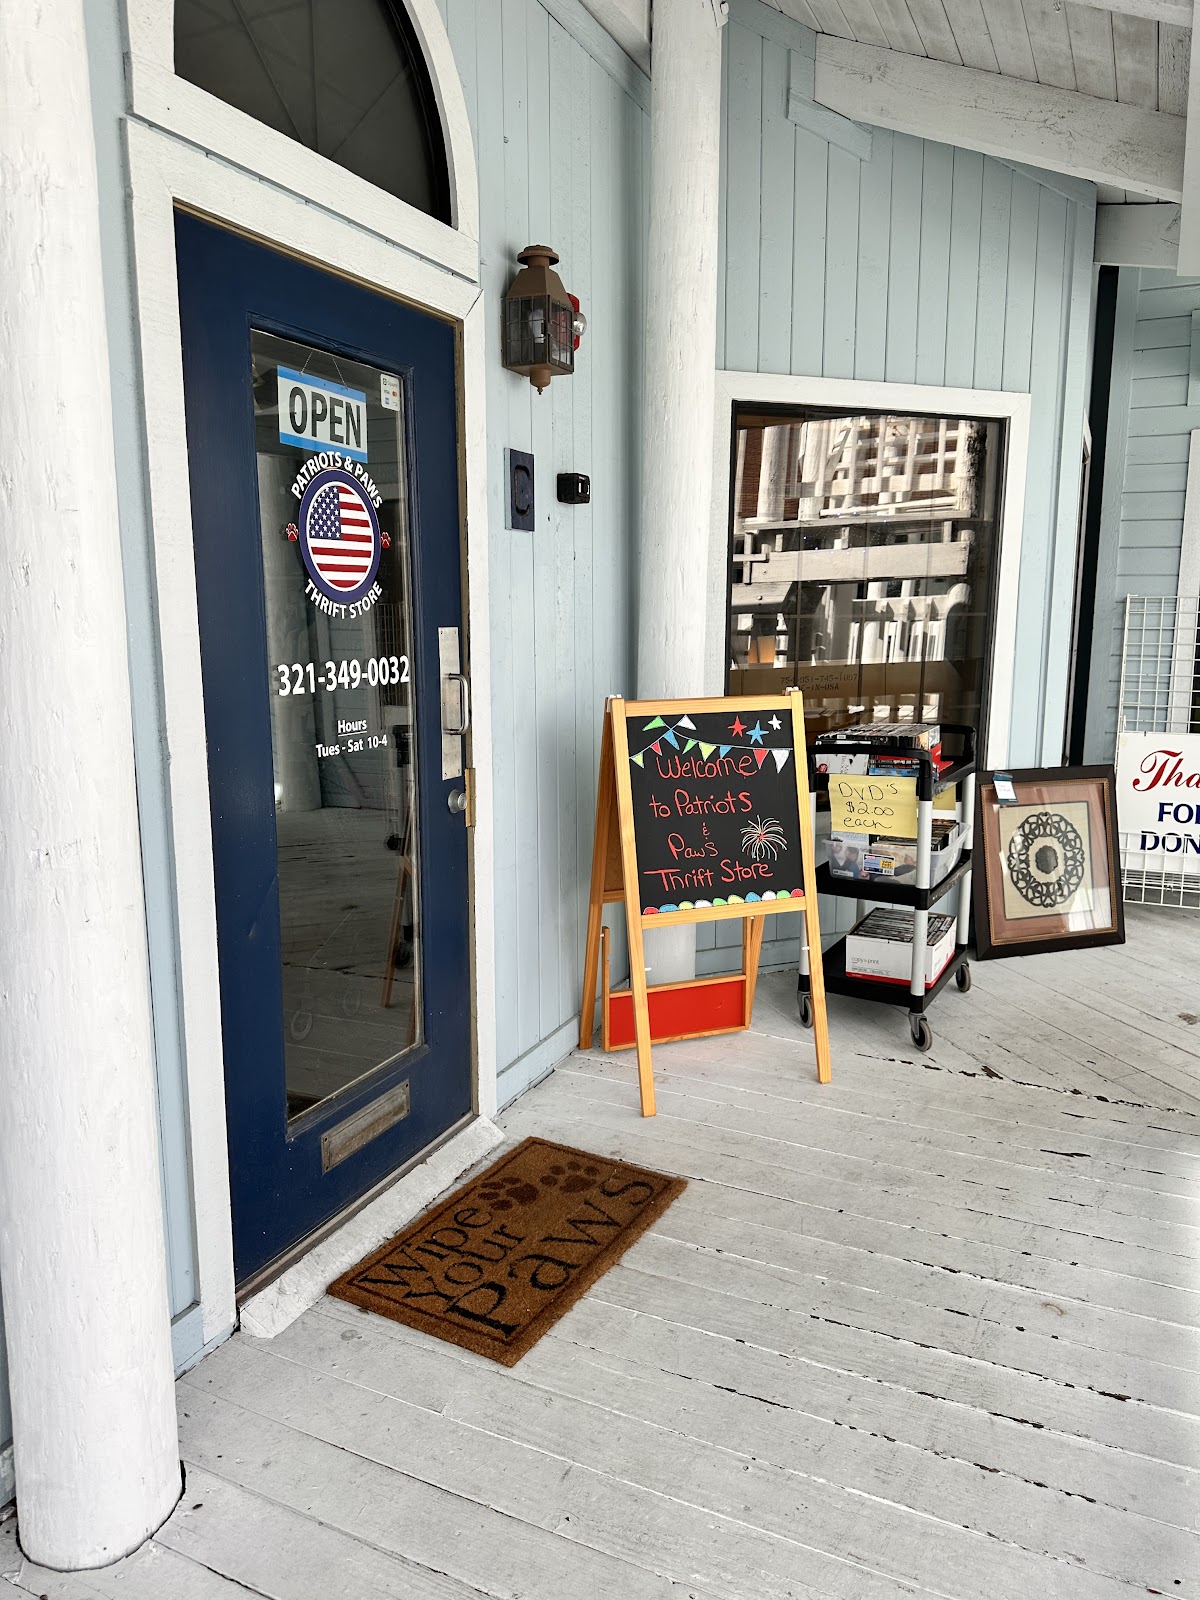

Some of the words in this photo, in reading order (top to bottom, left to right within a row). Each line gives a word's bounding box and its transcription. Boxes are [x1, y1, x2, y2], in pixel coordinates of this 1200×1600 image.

[288, 386, 362, 448] OPEN
[291, 451, 341, 499] PATRIOTS
[343, 455, 354, 472] &
[354, 466, 383, 508] PAWS
[304, 578, 347, 619] THRIFT
[350, 580, 383, 619] STORE
[277, 655, 410, 697] 321-349-0032
[337, 719, 368, 734] Hours
[315, 743, 340, 758] Tues
[347, 738, 364, 753] Sat
[367, 734, 388, 749] 10-4
[656, 755, 757, 779] Welcome
[649, 794, 671, 818] to
[674, 788, 753, 817] Patriots
[845, 801, 895, 816] $2.00
[843, 817, 893, 829] each
[644, 868, 714, 892] Thrift
[720, 859, 774, 883] Store
[358, 1207, 493, 1288] Wipe
[405, 1224, 526, 1304] Your
[445, 1175, 655, 1337] Paws
